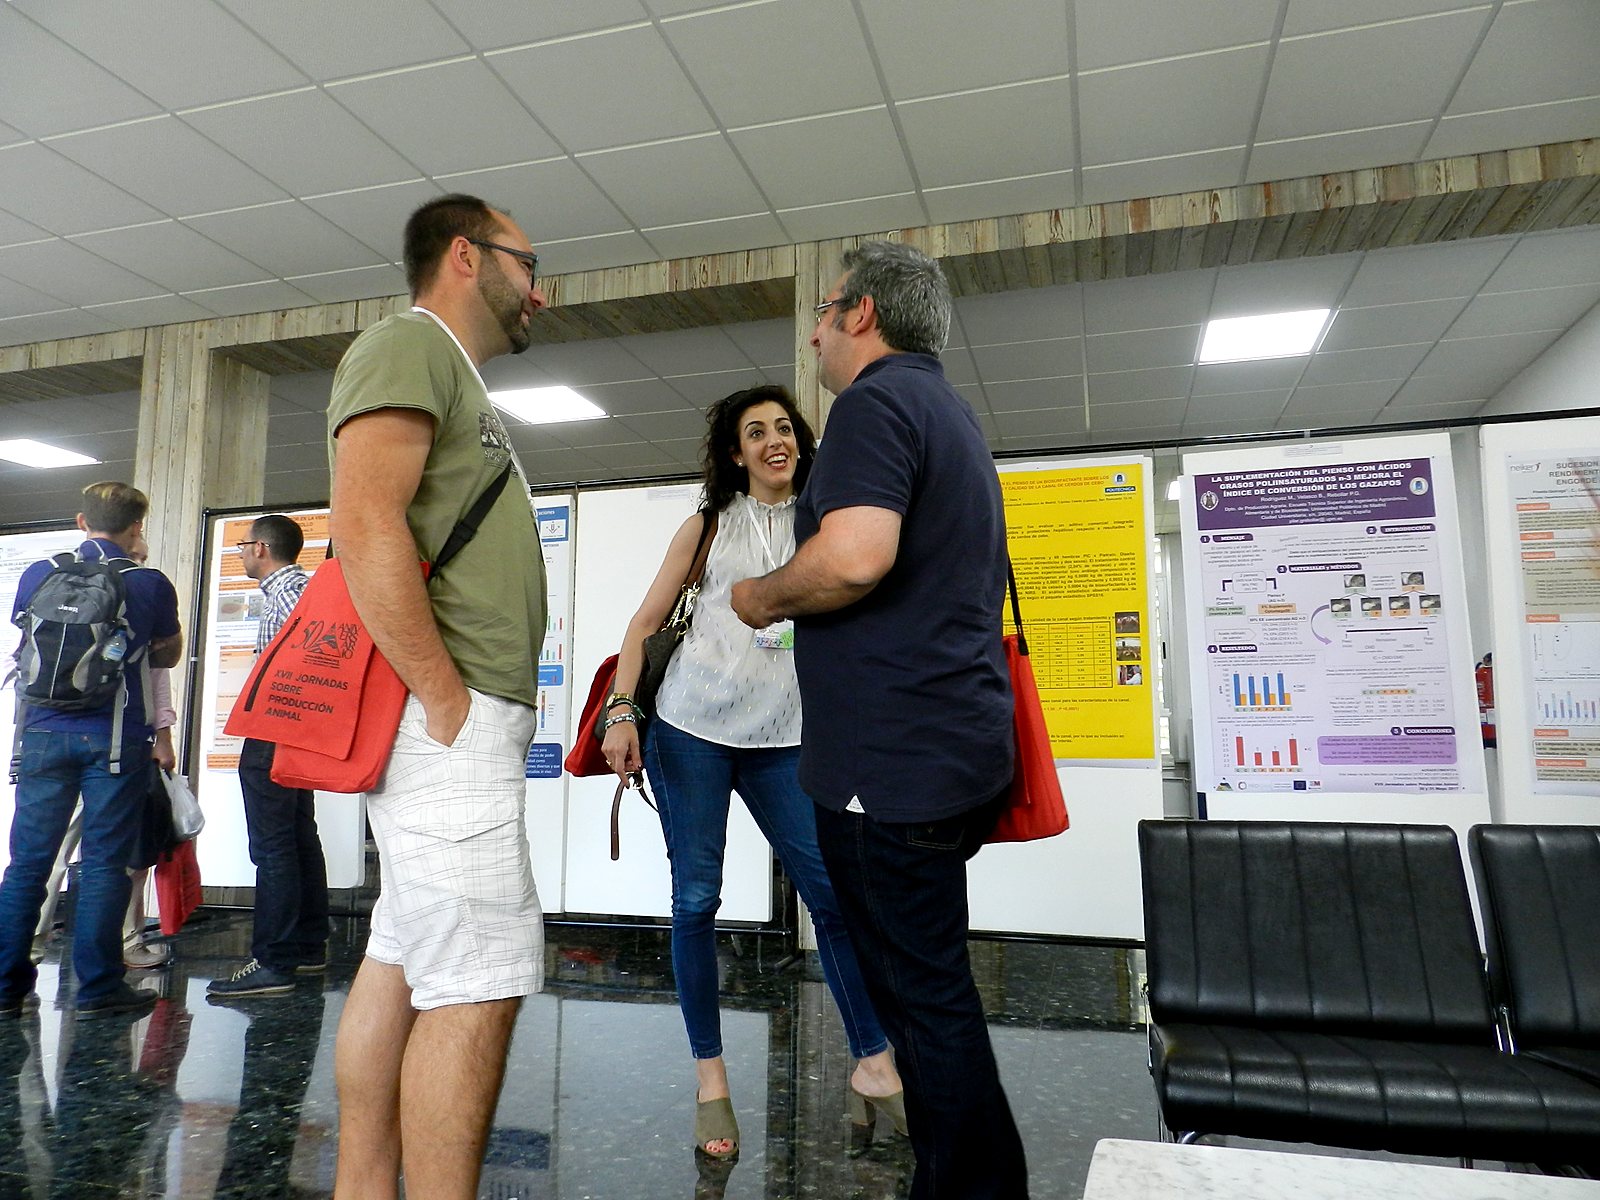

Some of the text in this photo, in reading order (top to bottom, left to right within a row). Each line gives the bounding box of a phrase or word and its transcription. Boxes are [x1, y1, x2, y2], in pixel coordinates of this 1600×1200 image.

[1224, 470, 1300, 482] SUPLEMENTACIÓN
[1549, 469, 1600, 477] RENDIMIENT
[1220, 481, 1254, 489] GRASOS
[1256, 476, 1336, 486] POLIINSATURADOS
[1354, 472, 1390, 480] MEJORA
[1224, 489, 1252, 497] ÍNDICE
[1268, 485, 1324, 494] CONVERSIÓN
[1359, 480, 1401, 488] GAZAPOS
[58, 604, 78, 613] Jeep
[274, 670, 348, 690] XVII JORNADAS
[271, 682, 302, 695] SOBRE
[268, 695, 333, 713] PRODUCCIÓN
[265, 708, 302, 721] ANIMAL
